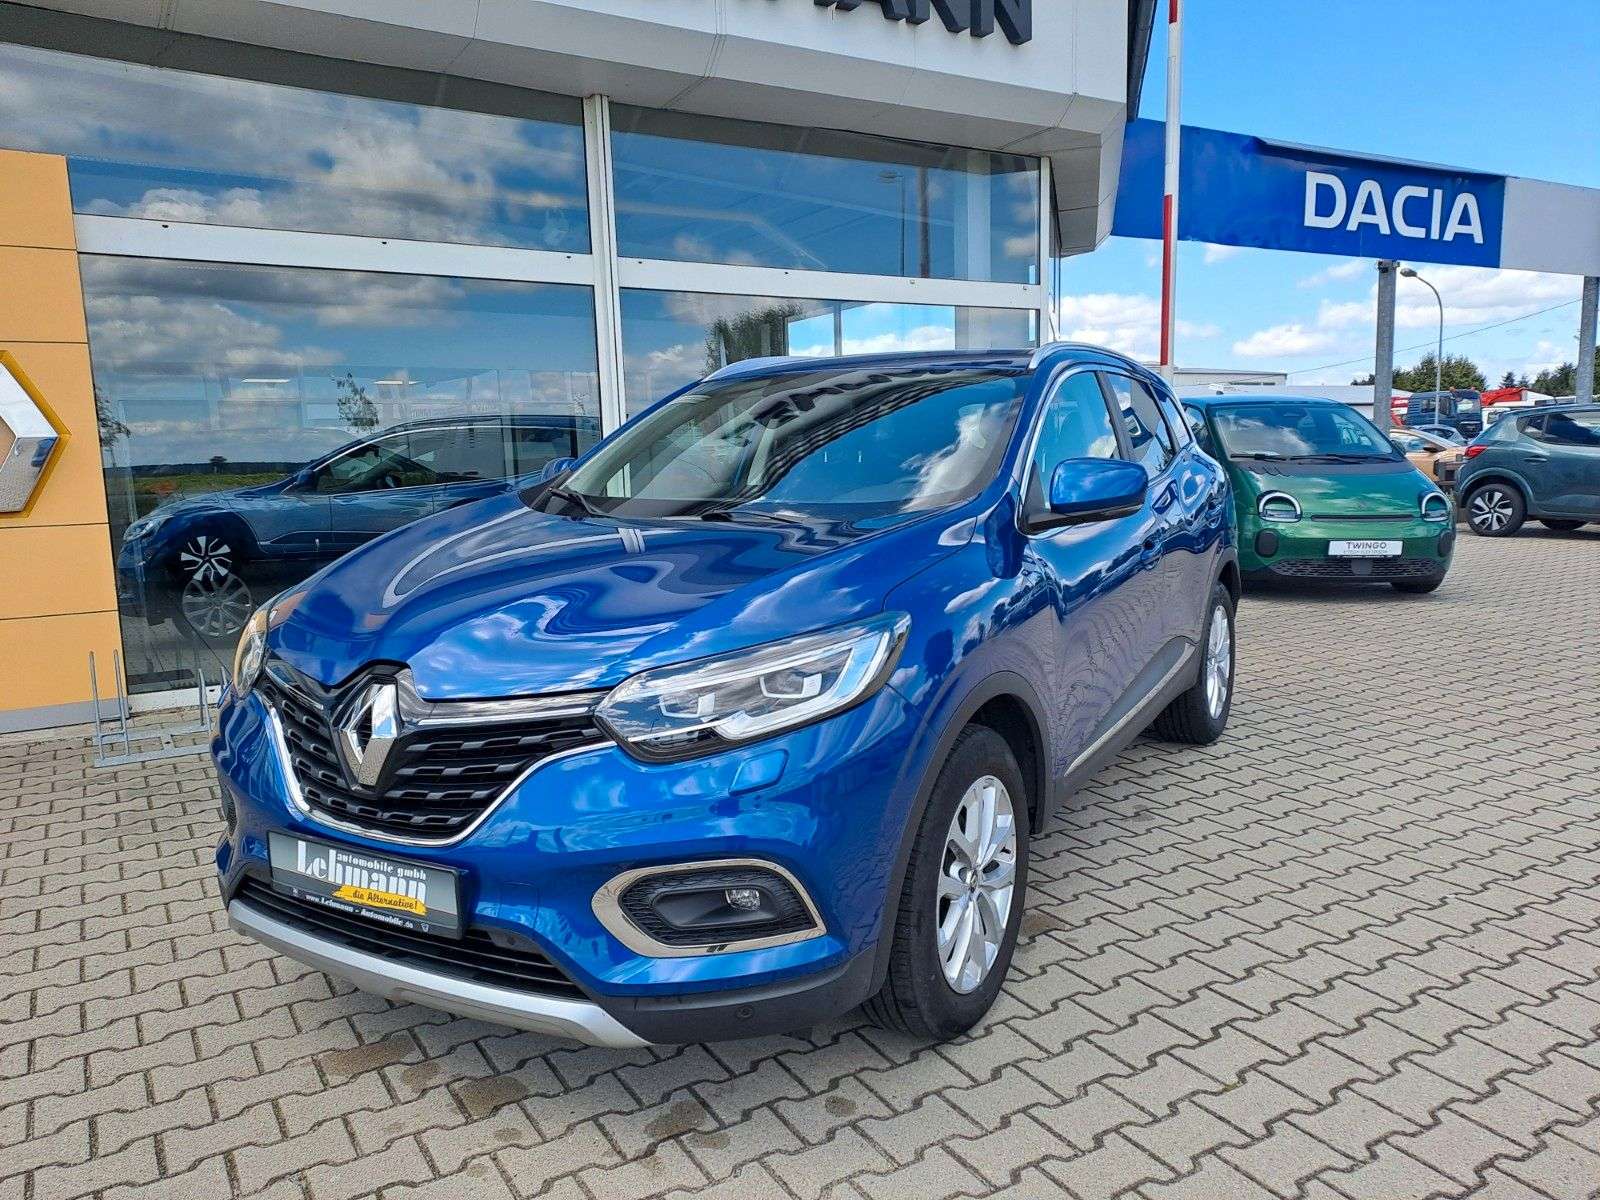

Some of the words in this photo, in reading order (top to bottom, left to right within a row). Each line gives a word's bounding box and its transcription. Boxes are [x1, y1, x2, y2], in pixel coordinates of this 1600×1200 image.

[1304, 171, 1483, 244] DACIA
[1346, 541, 1387, 549] TWINGO
[297, 840, 426, 905] Lehmann
[336, 853, 394, 873] automobile
[397, 867, 427, 880] gmbh
[352, 889, 365, 899] die
[367, 892, 418, 909] Alternative!
